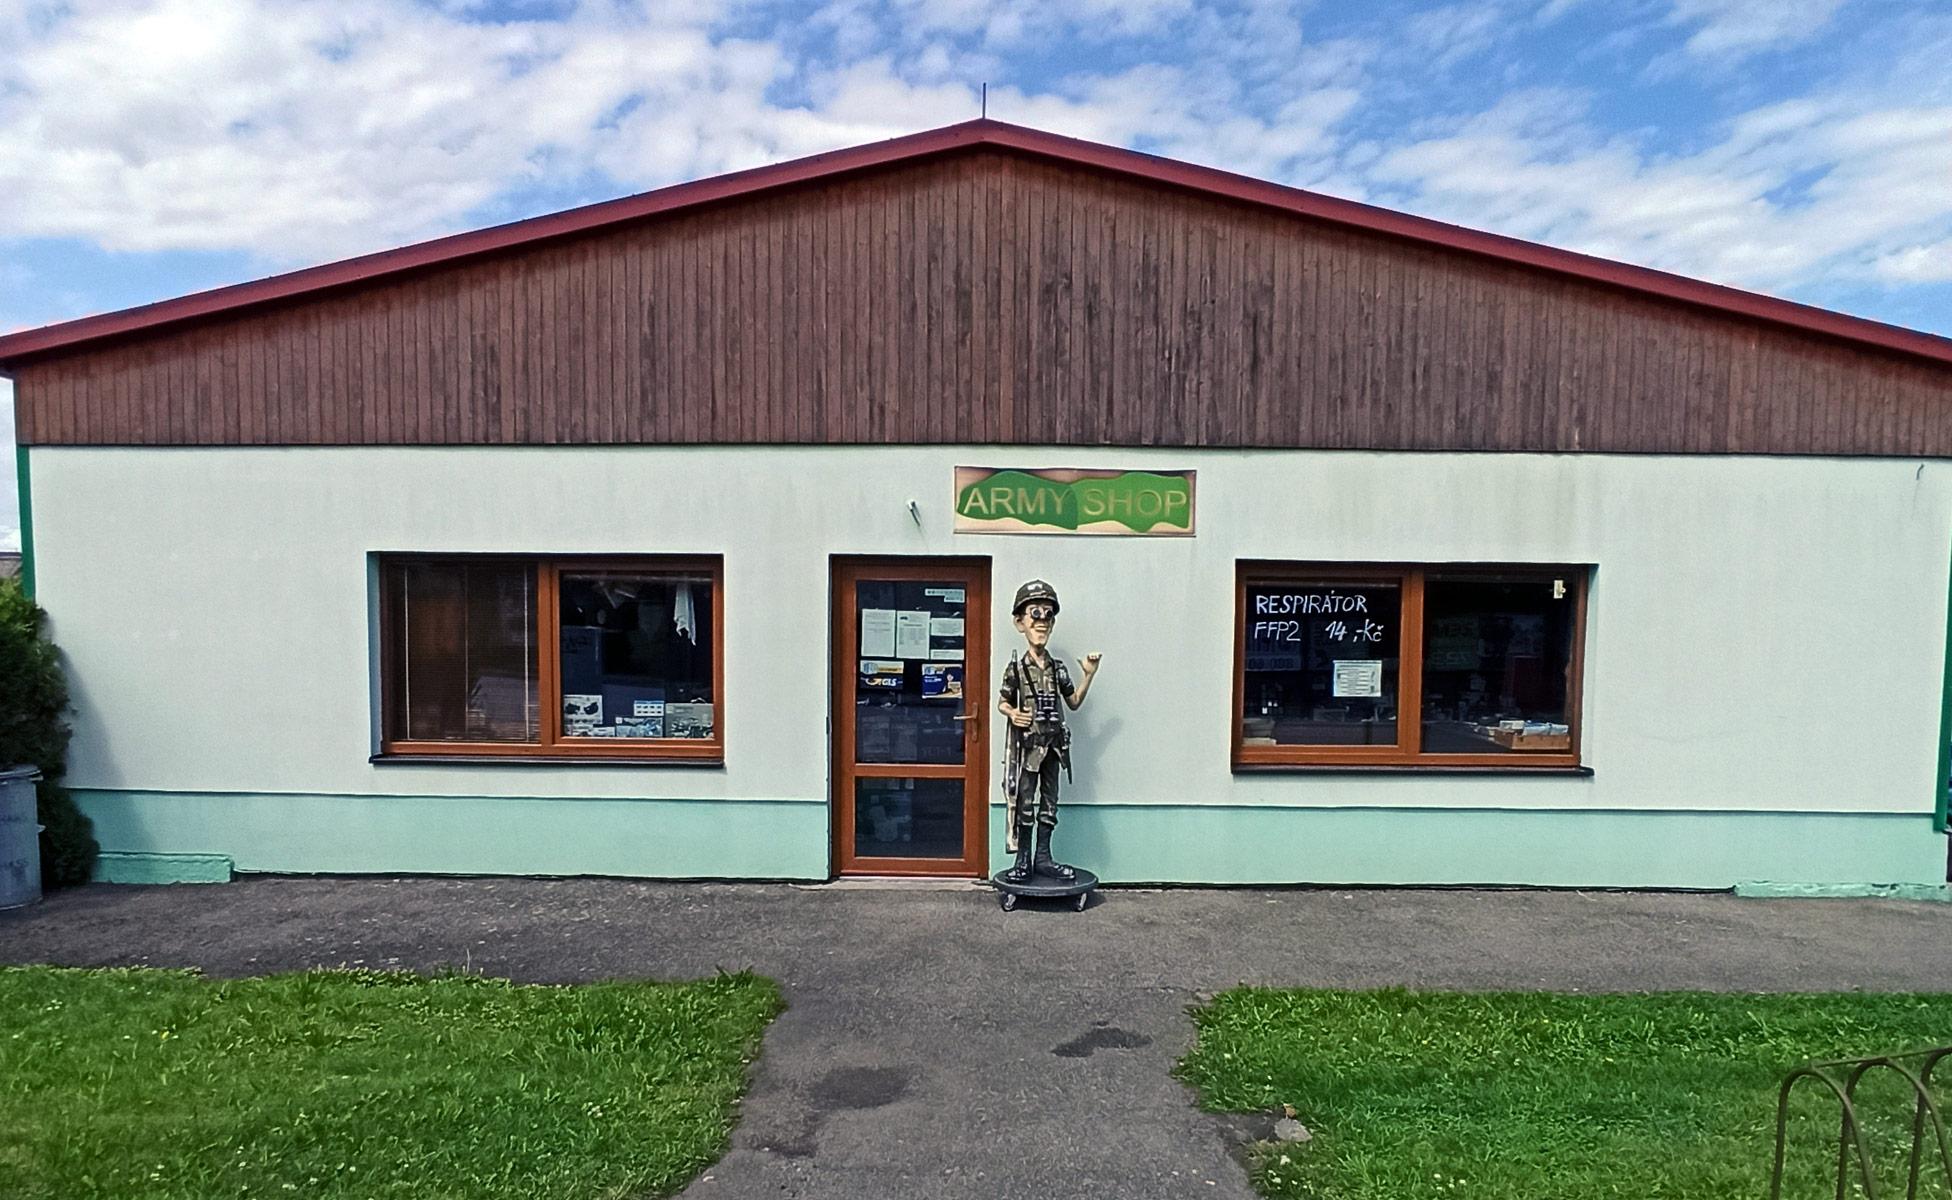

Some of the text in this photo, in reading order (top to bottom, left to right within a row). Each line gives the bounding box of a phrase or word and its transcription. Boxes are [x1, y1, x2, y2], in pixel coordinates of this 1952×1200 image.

[963, 487, 1187, 516] ARMY SHOP
[1254, 621, 1301, 641] FFP2
